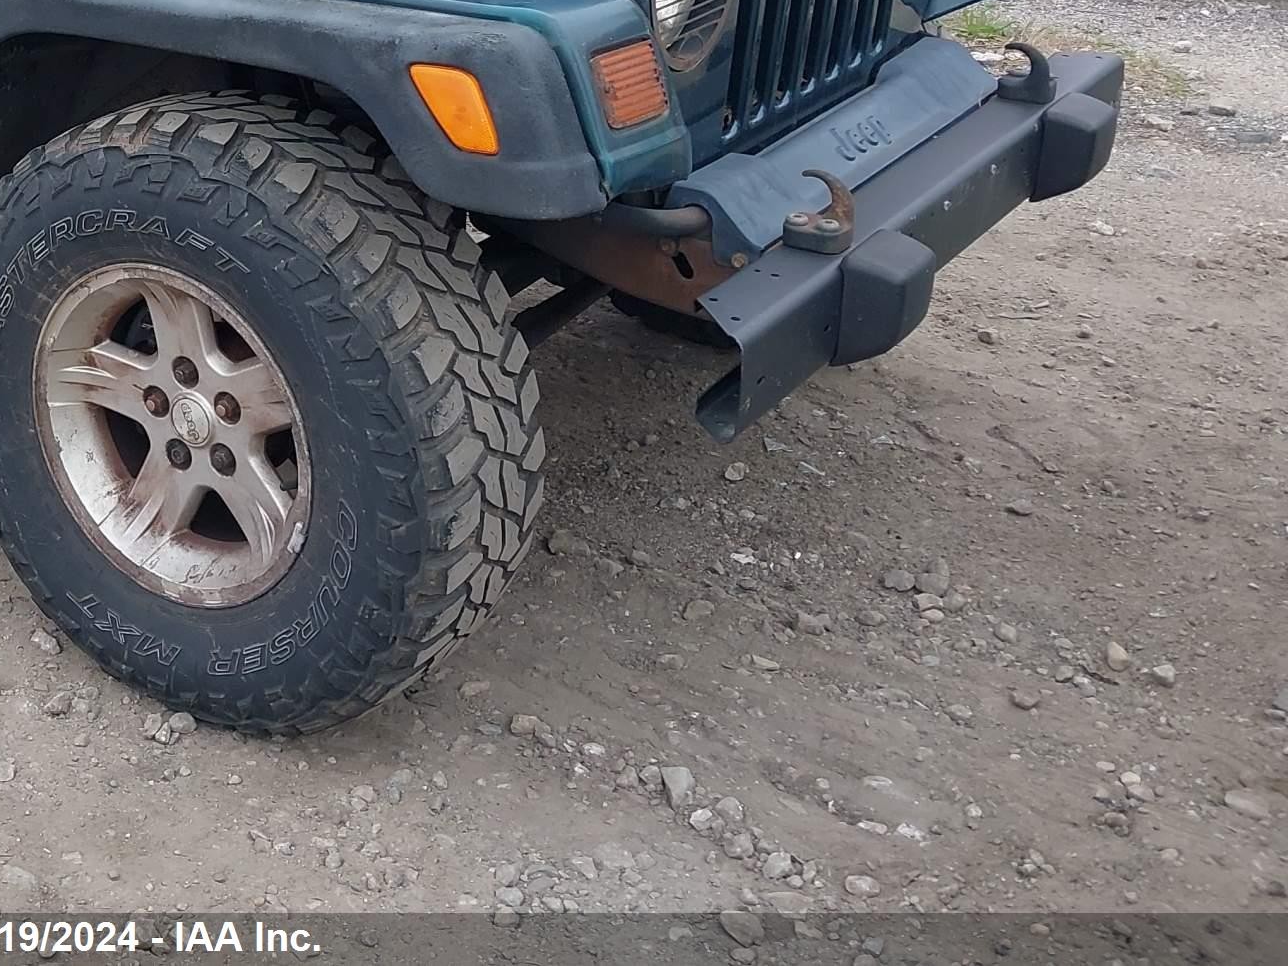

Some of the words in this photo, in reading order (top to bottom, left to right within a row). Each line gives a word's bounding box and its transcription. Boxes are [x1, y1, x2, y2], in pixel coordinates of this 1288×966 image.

[829, 115, 892, 162] Jeep
[208, 498, 358, 676] COURSER
[65, 590, 182, 667] MXT
